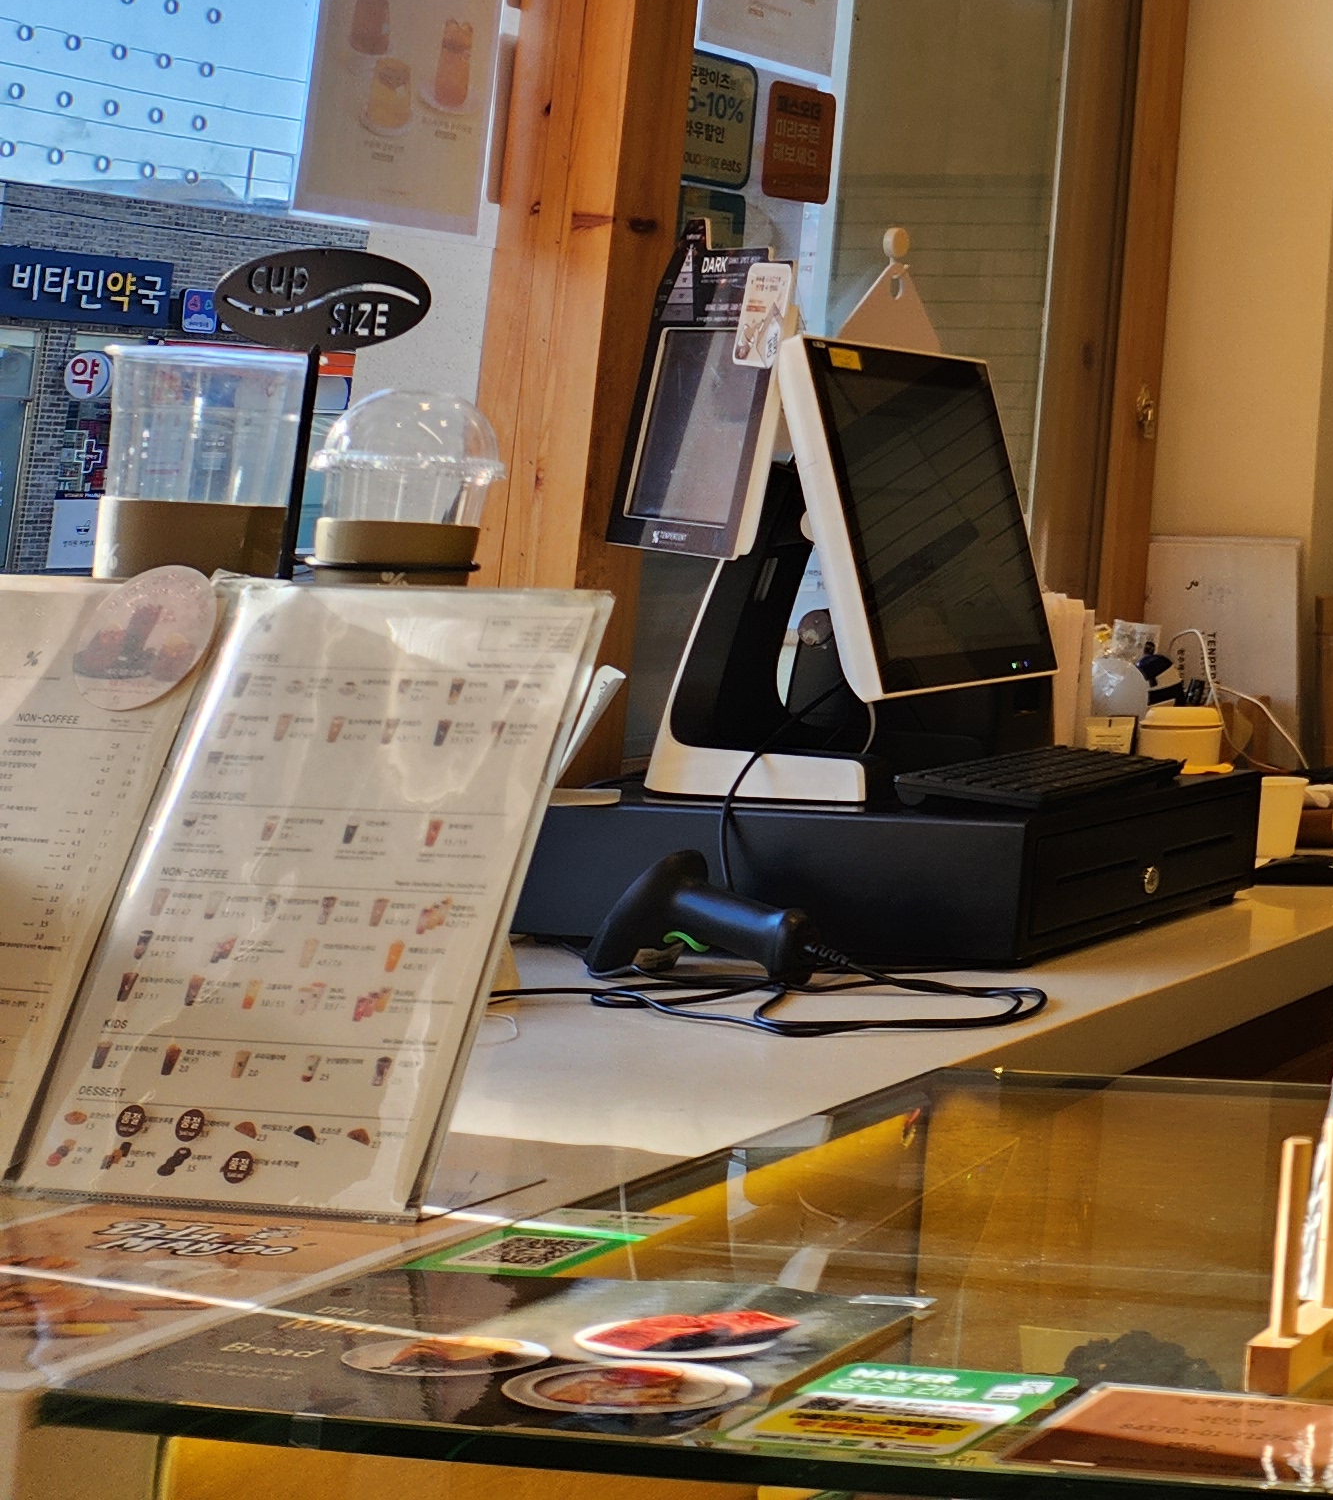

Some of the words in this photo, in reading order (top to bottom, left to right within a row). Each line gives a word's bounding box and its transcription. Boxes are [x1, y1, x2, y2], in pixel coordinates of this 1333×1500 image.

[721, 159, 742, 174] eats
[701, 256, 729, 274] DARK
[11, 263, 167, 315] 비타민약국
[329, 302, 390, 337] SIZE
[71, 358, 100, 395] 약
[16, 712, 81, 726] NON-COFFEE
[189, 790, 248, 802] SIGNATURE
[161, 866, 230, 879] NON-COFFEE
[102, 1018, 129, 1030] KIDS
[78, 1085, 127, 1098] DESSERT
[121, 1110, 145, 1126] 품절
[180, 1115, 203, 1130] 품절
[228, 1157, 250, 1172] 품절
[219, 1342, 326, 1359] Bread
[848, 1367, 961, 1385] NAVER
